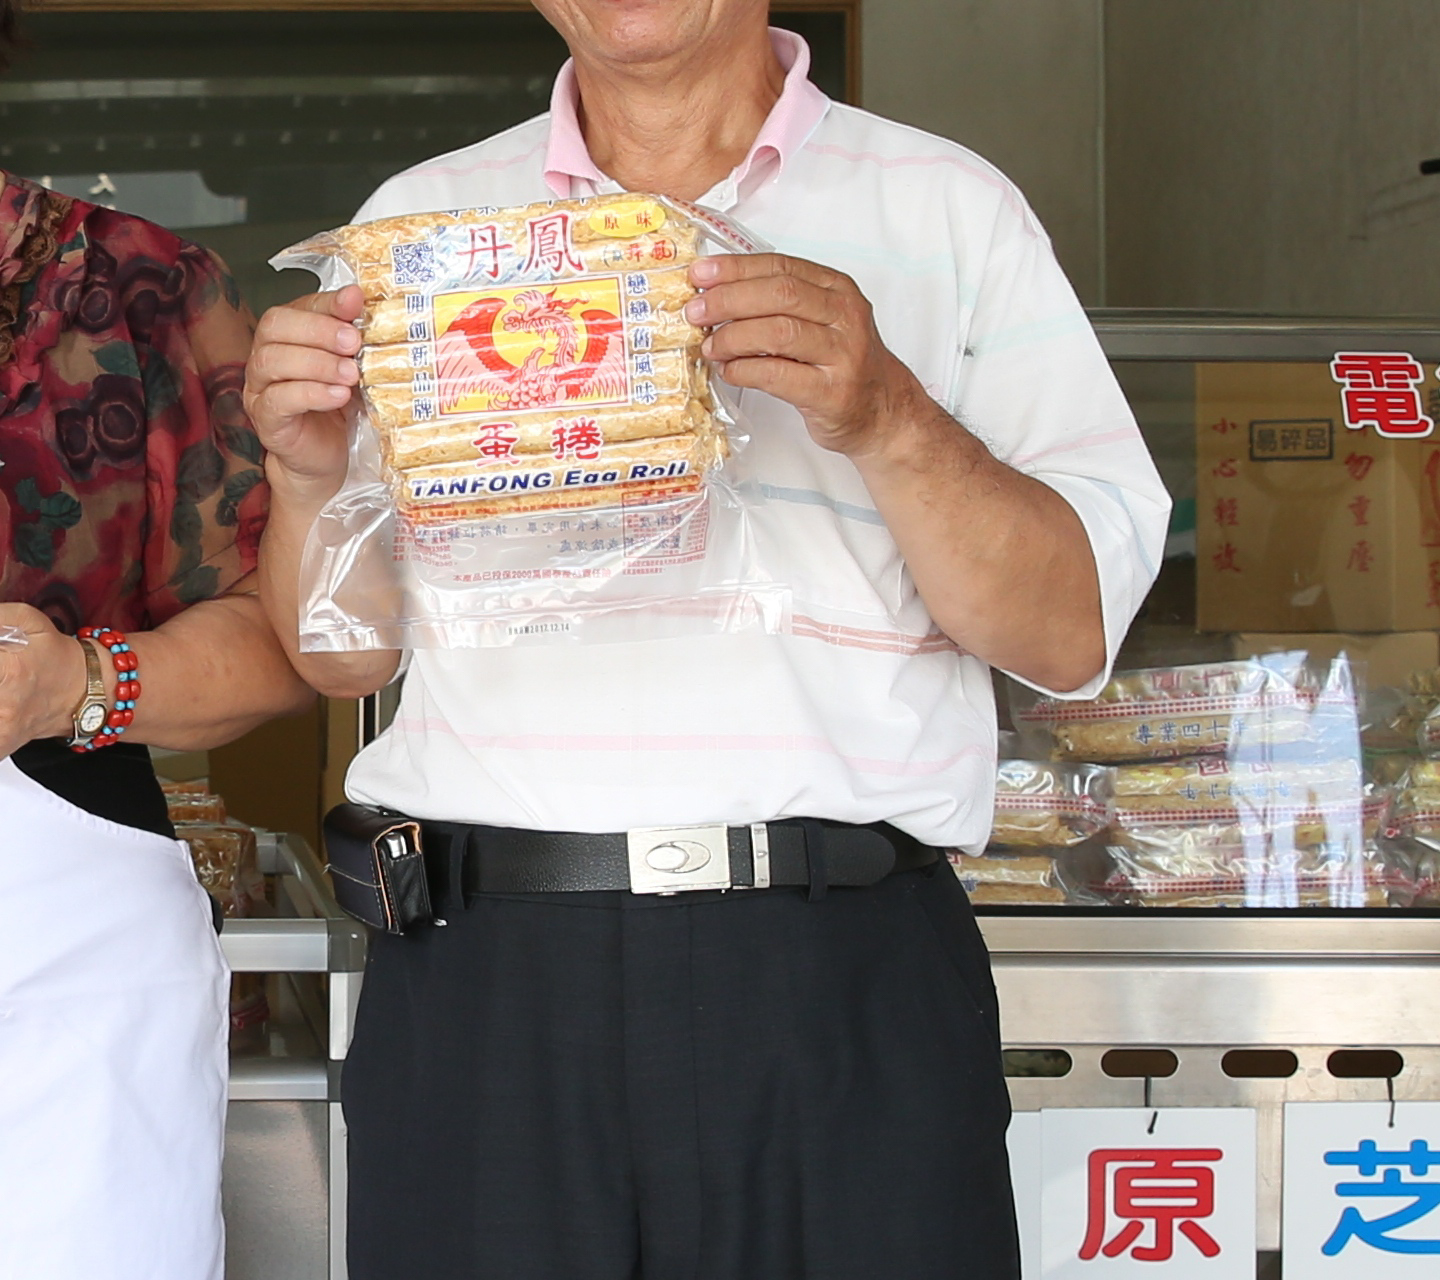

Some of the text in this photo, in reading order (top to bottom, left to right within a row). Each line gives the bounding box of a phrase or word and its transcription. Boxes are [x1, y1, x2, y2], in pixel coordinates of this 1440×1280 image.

[604, 212, 652, 230] 原味
[457, 213, 584, 278] 丹鳳
[627, 275, 657, 404] 戀戀舊風味
[474, 420, 603, 466] 蛋捲
[1256, 427, 1328, 452] 易碎品
[411, 472, 553, 498] TANFONG
